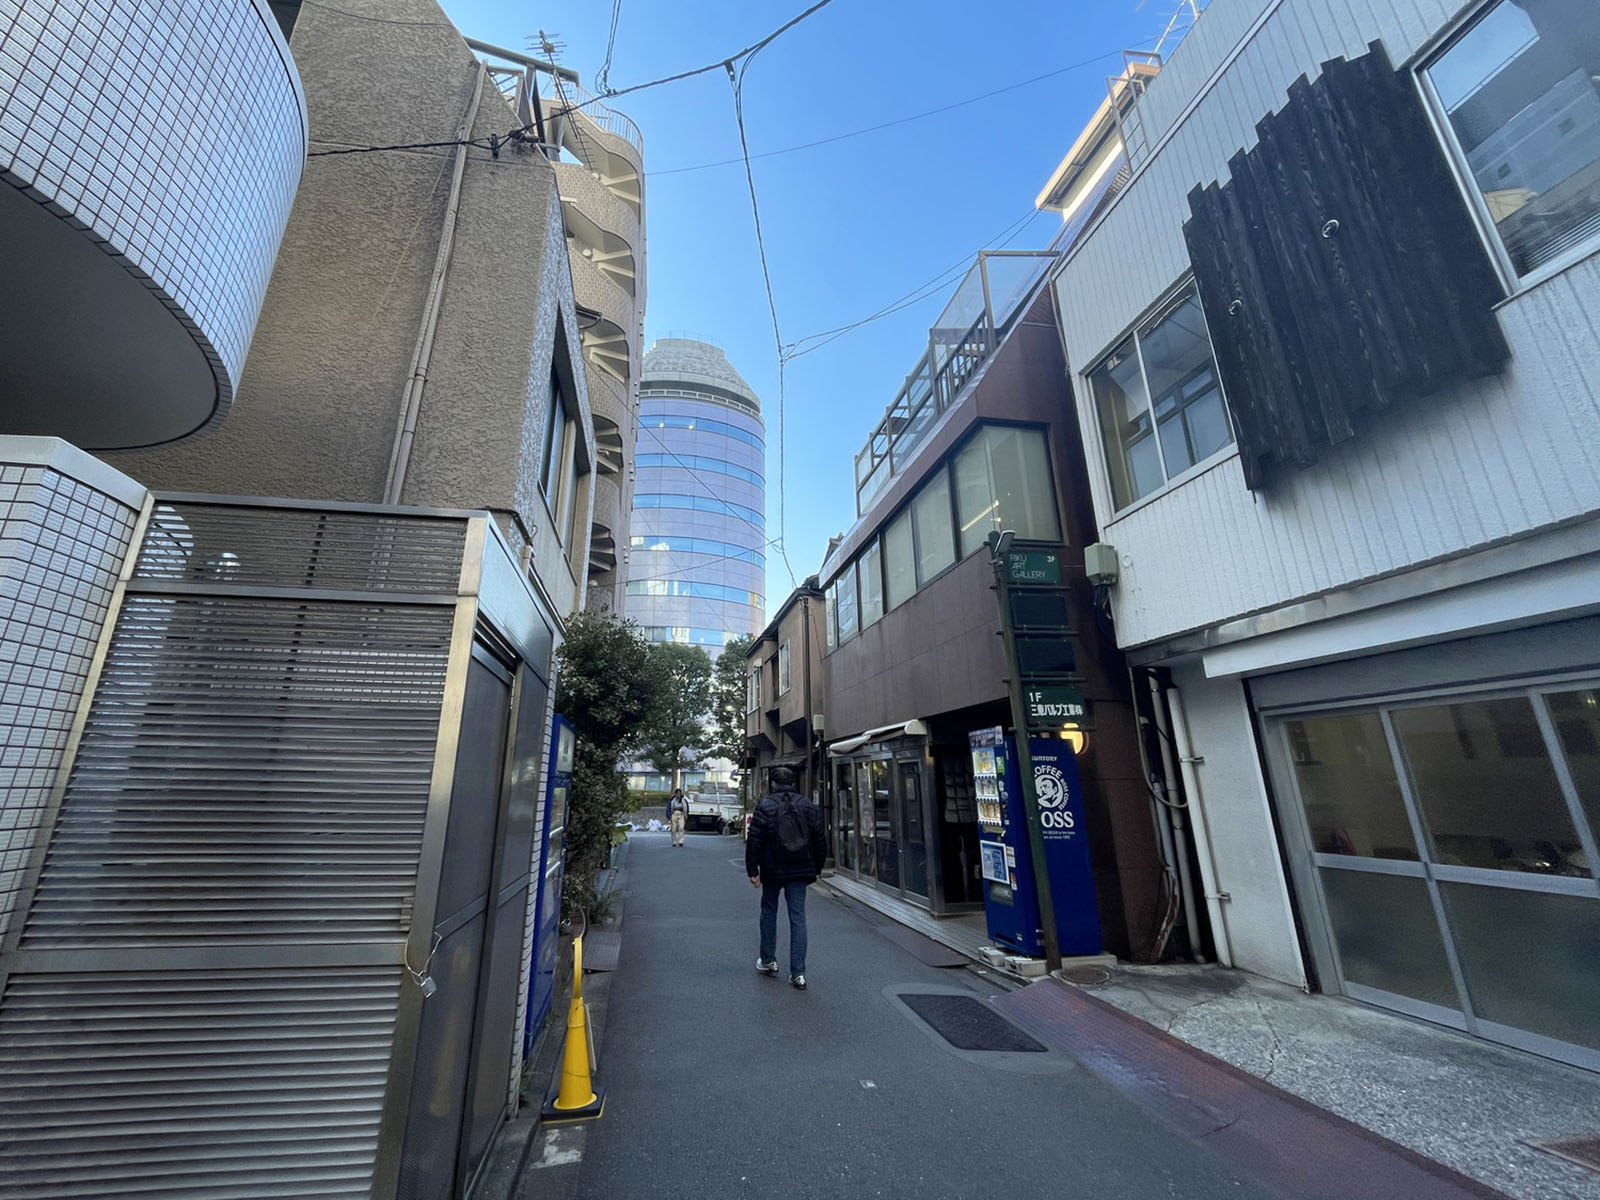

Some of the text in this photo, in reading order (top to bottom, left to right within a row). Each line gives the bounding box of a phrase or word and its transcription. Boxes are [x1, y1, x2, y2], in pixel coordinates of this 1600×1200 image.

[1011, 562, 1026, 570] ART
[1012, 570, 1046, 578] GALLERY
[1029, 692, 1042, 702] 1F
[1033, 764, 1063, 779] OFFEE
[1040, 810, 1075, 828] OSS
